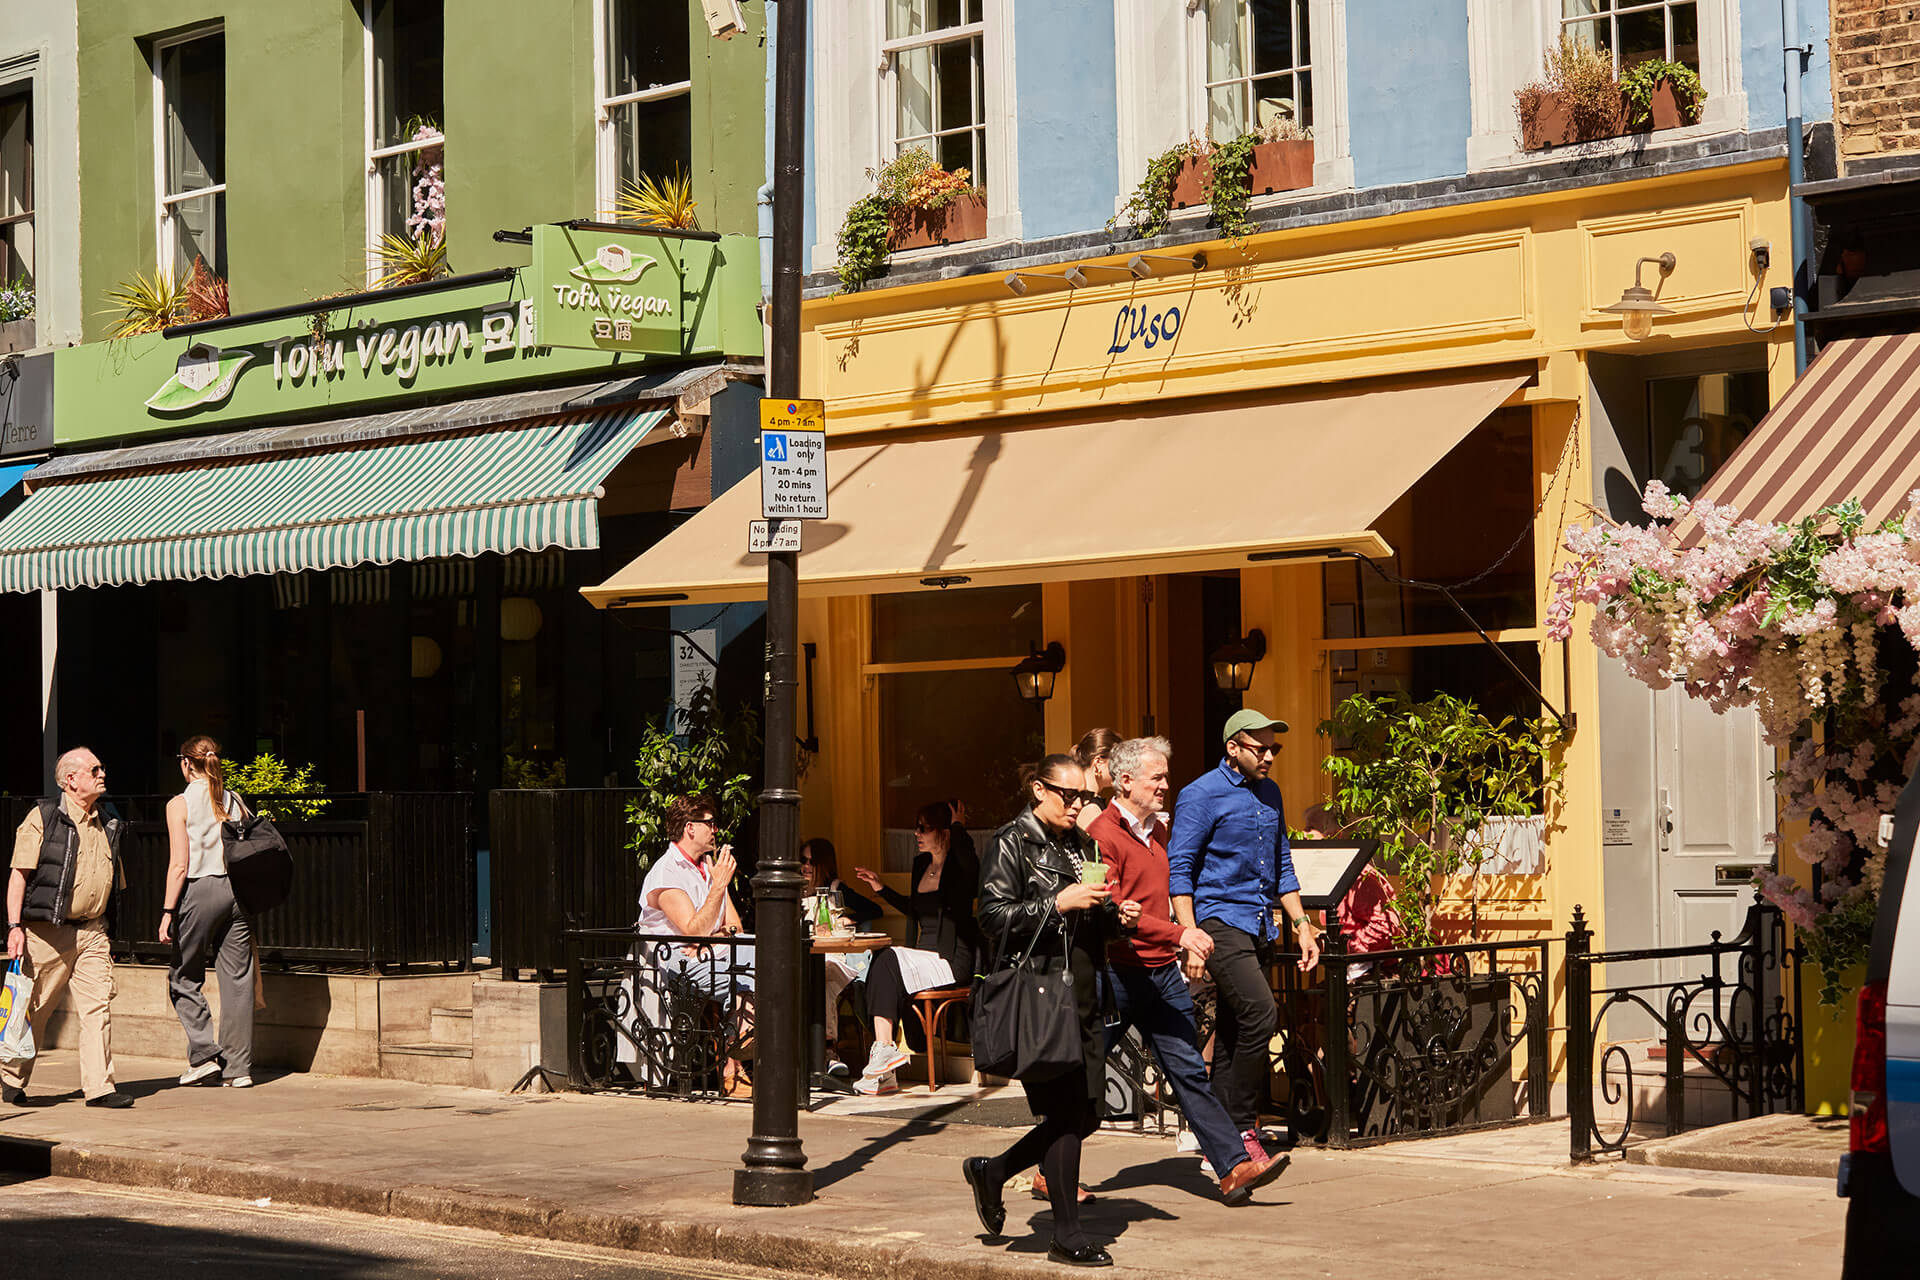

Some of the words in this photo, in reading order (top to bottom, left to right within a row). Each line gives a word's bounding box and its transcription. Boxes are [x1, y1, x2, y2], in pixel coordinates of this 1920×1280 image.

[552, 282, 601, 307] Tofu
[595, 317, 632, 341] 豆腐
[3, 422, 37, 444] Terre
[790, 438, 822, 449] Loading
[797, 449, 814, 460] only
[778, 480, 790, 488] 20
[791, 481, 811, 489] mins
[775, 493, 786, 502] No
[789, 494, 816, 502] return
[768, 504, 794, 512] within
[803, 504, 822, 513] hour
[754, 526, 765, 534] No
[680, 646, 693, 660] 32
